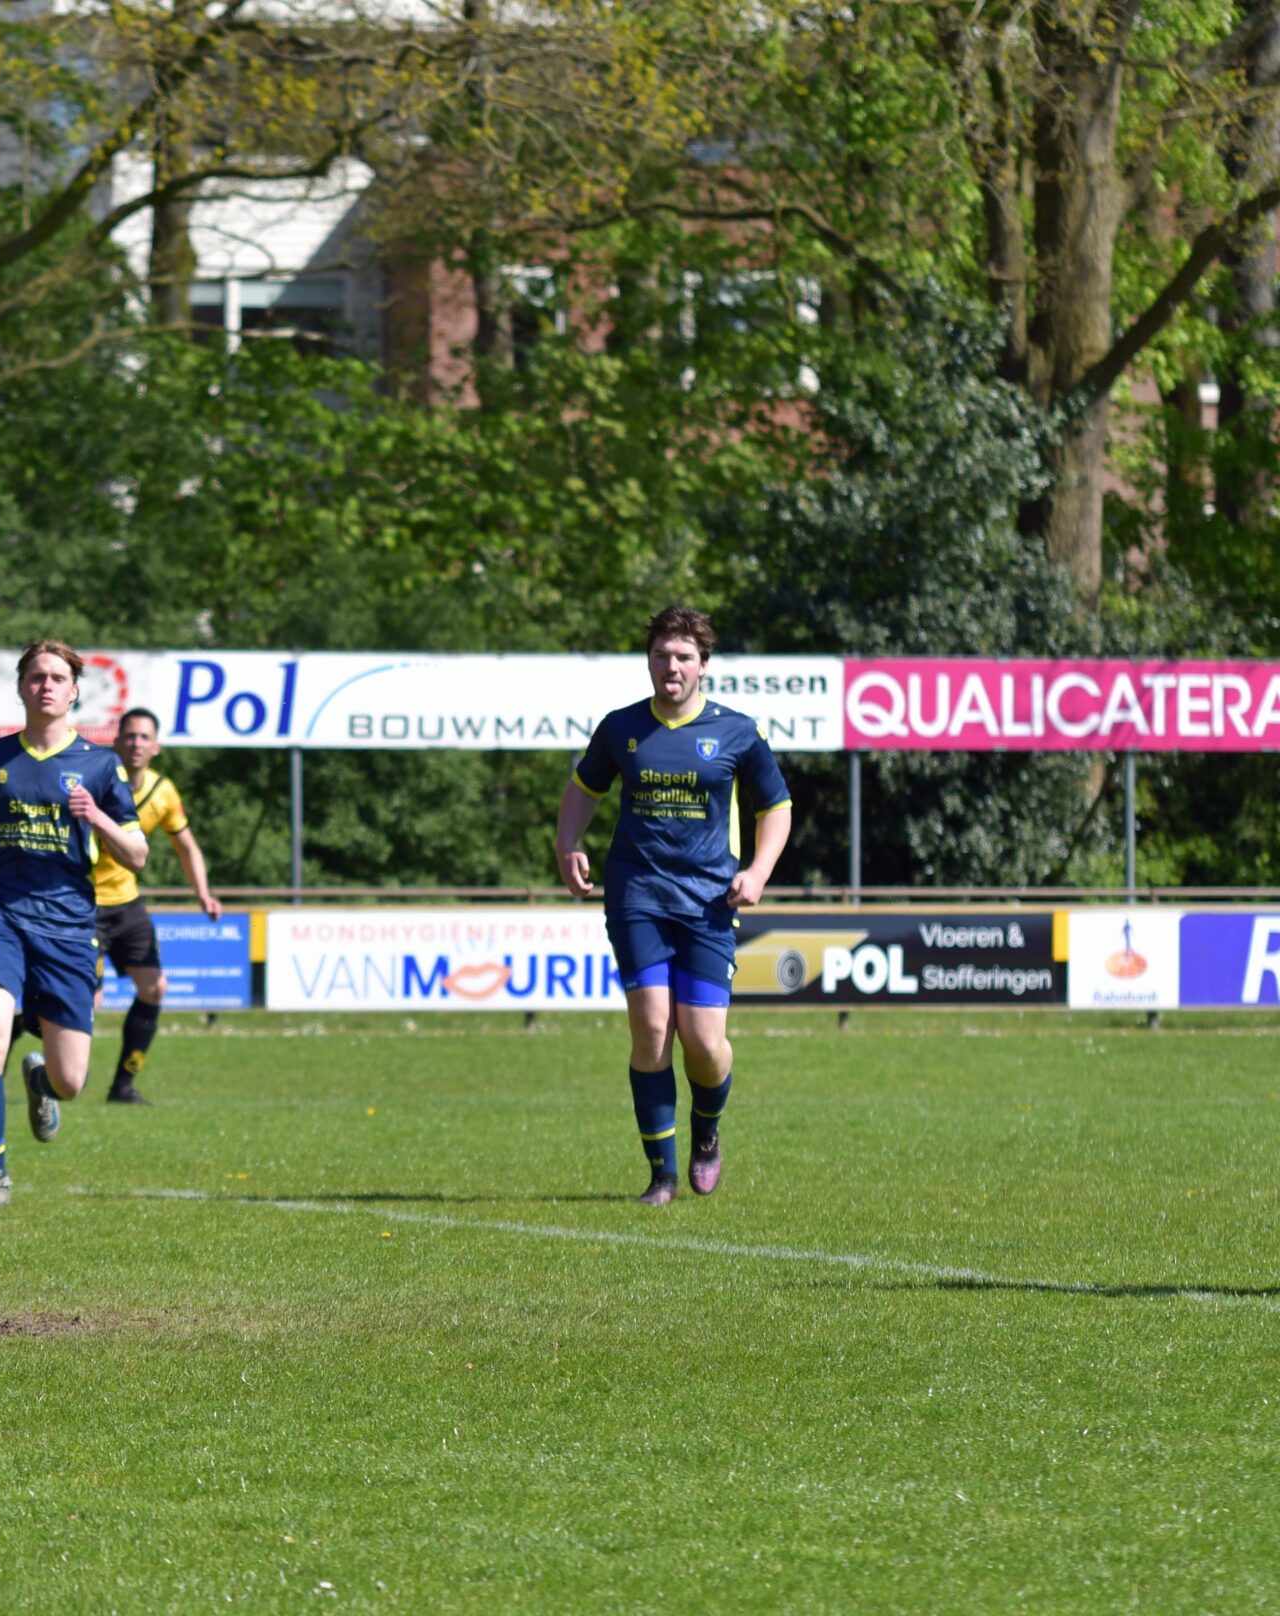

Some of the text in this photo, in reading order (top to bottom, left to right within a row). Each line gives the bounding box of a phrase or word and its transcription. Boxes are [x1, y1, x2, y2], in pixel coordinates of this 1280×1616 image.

[172, 659, 300, 737] Pol
[640, 769, 698, 787] Slagerij
[9, 800, 61, 820] Slagerij
[919, 922, 1026, 949] Vloeren &
[821, 944, 918, 994] POL
[922, 963, 1053, 996] Stofferingen
